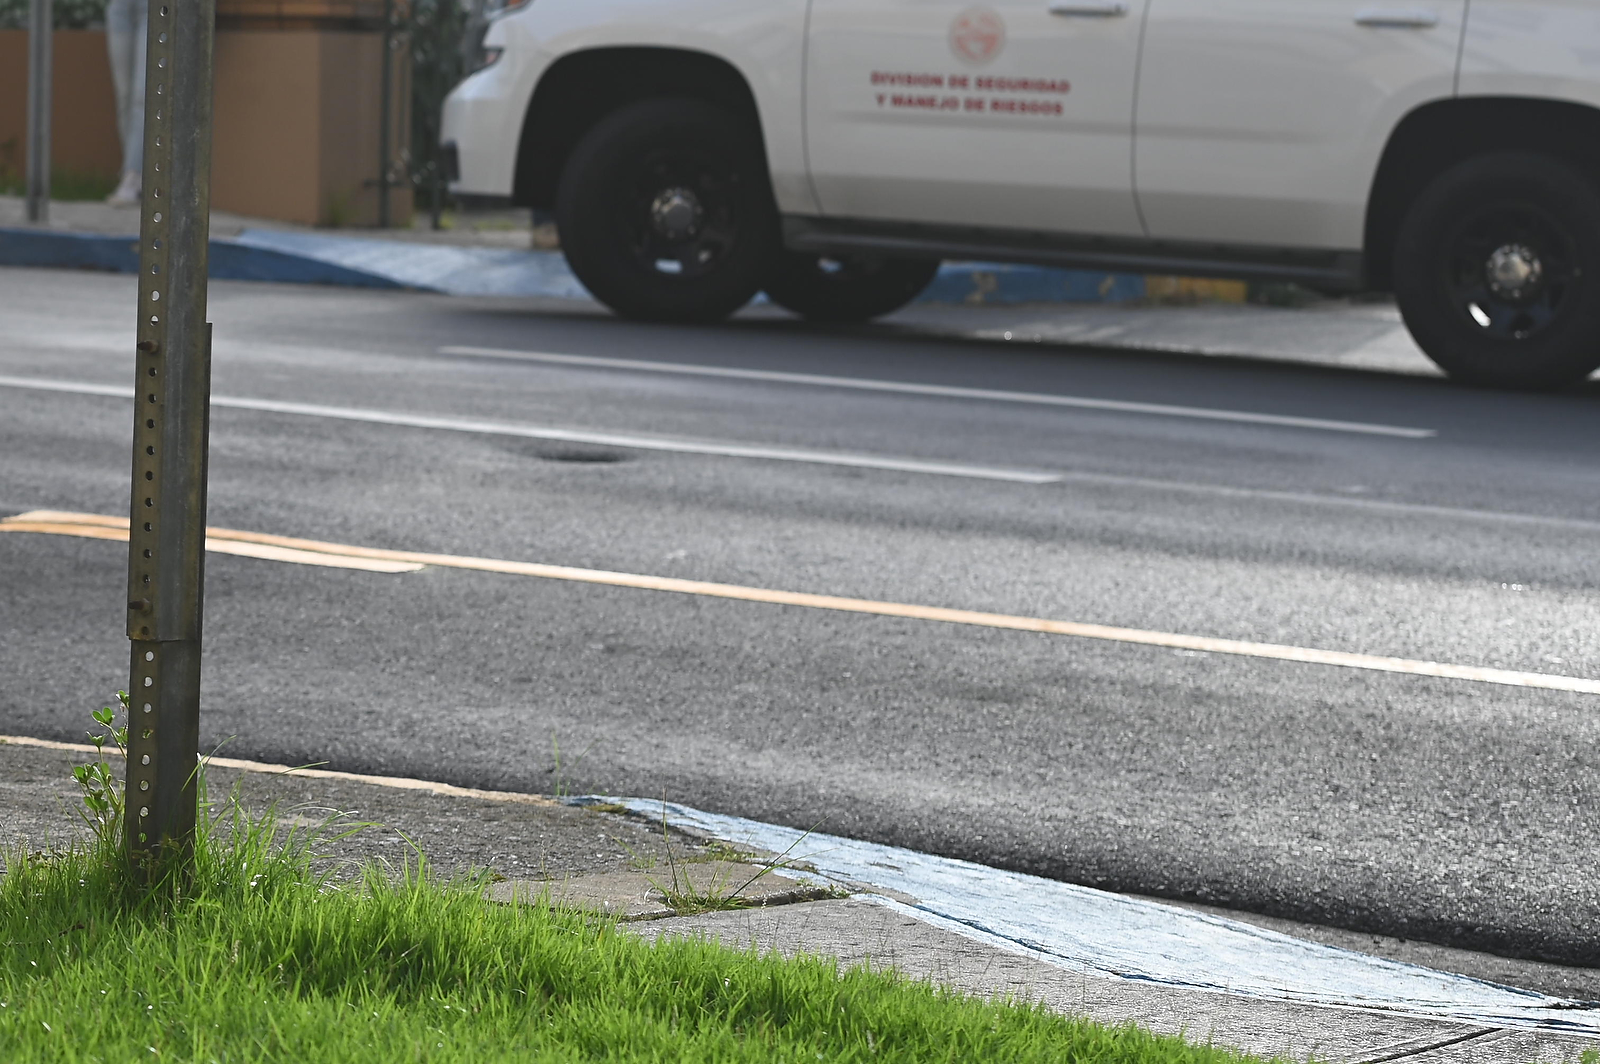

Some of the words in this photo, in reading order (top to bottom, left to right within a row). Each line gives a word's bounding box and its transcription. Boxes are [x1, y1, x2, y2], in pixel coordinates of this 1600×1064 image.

[949, 74, 969, 89] DE
[975, 76, 1070, 93] SEGURIDAD
[876, 93, 886, 107] Y
[891, 94, 960, 111] MANEJO
[964, 97, 984, 112] DE
[991, 99, 1063, 115] RIESGOS
